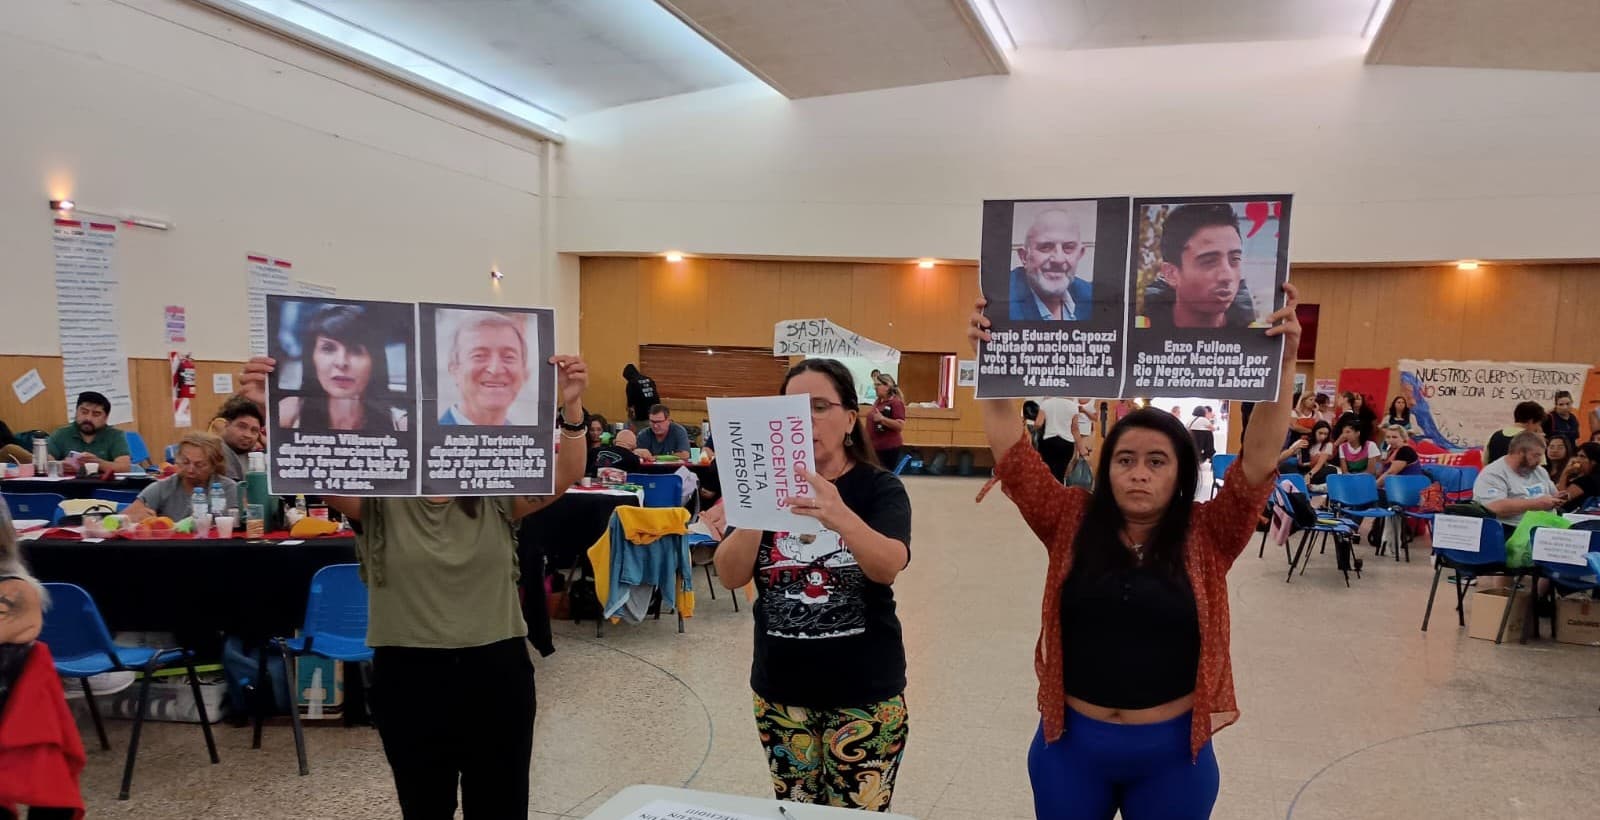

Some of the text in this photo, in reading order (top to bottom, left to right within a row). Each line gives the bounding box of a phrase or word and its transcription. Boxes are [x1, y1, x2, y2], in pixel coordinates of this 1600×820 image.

[1022, 329, 1069, 341] Eduardo
[1072, 330, 1117, 344] Capozzi
[986, 341, 1110, 355] diputado nacional que
[1164, 340, 1241, 352] Enzo Fullone
[984, 352, 1112, 367] voto a favor de bajar la
[1137, 351, 1268, 367] Senador Nacional por
[980, 363, 1115, 377] edad de imputabilidad a
[1155, 364, 1195, 378] Negro,
[1199, 365, 1224, 376] voto
[1228, 367, 1235, 376] a
[1239, 364, 1271, 377] favor
[1416, 367, 1472, 384] NUESTROS
[1475, 369, 1518, 384] CUERPOS
[1023, 375, 1070, 387] 14 años.
[1135, 375, 1265, 388] de la reforma Laboral
[1419, 384, 1436, 398] NO
[1437, 384, 1457, 397] SON
[1462, 386, 1486, 397] ZONA
[1492, 386, 1505, 399] DE
[294, 432, 398, 446] Lorena Villaverde
[334, 446, 384, 457] nacional
[386, 448, 409, 460] que
[479, 446, 524, 457] nacional
[525, 448, 545, 459] que
[787, 416, 809, 499] ¡NO SOBR
[276, 456, 410, 470] voto a favor de bajar la
[427, 457, 547, 470] voto a favor de bajar la
[728, 421, 752, 509] INVERSIÓN!
[751, 443, 768, 491] FALTA
[769, 421, 791, 511] DOCENTES,
[279, 467, 309, 478] edad
[312, 467, 327, 478] de
[429, 467, 456, 479] edad
[458, 468, 472, 479] de
[314, 480, 323, 490] a
[326, 478, 340, 490] 14
[460, 480, 468, 489] a
[470, 478, 484, 489] 14
